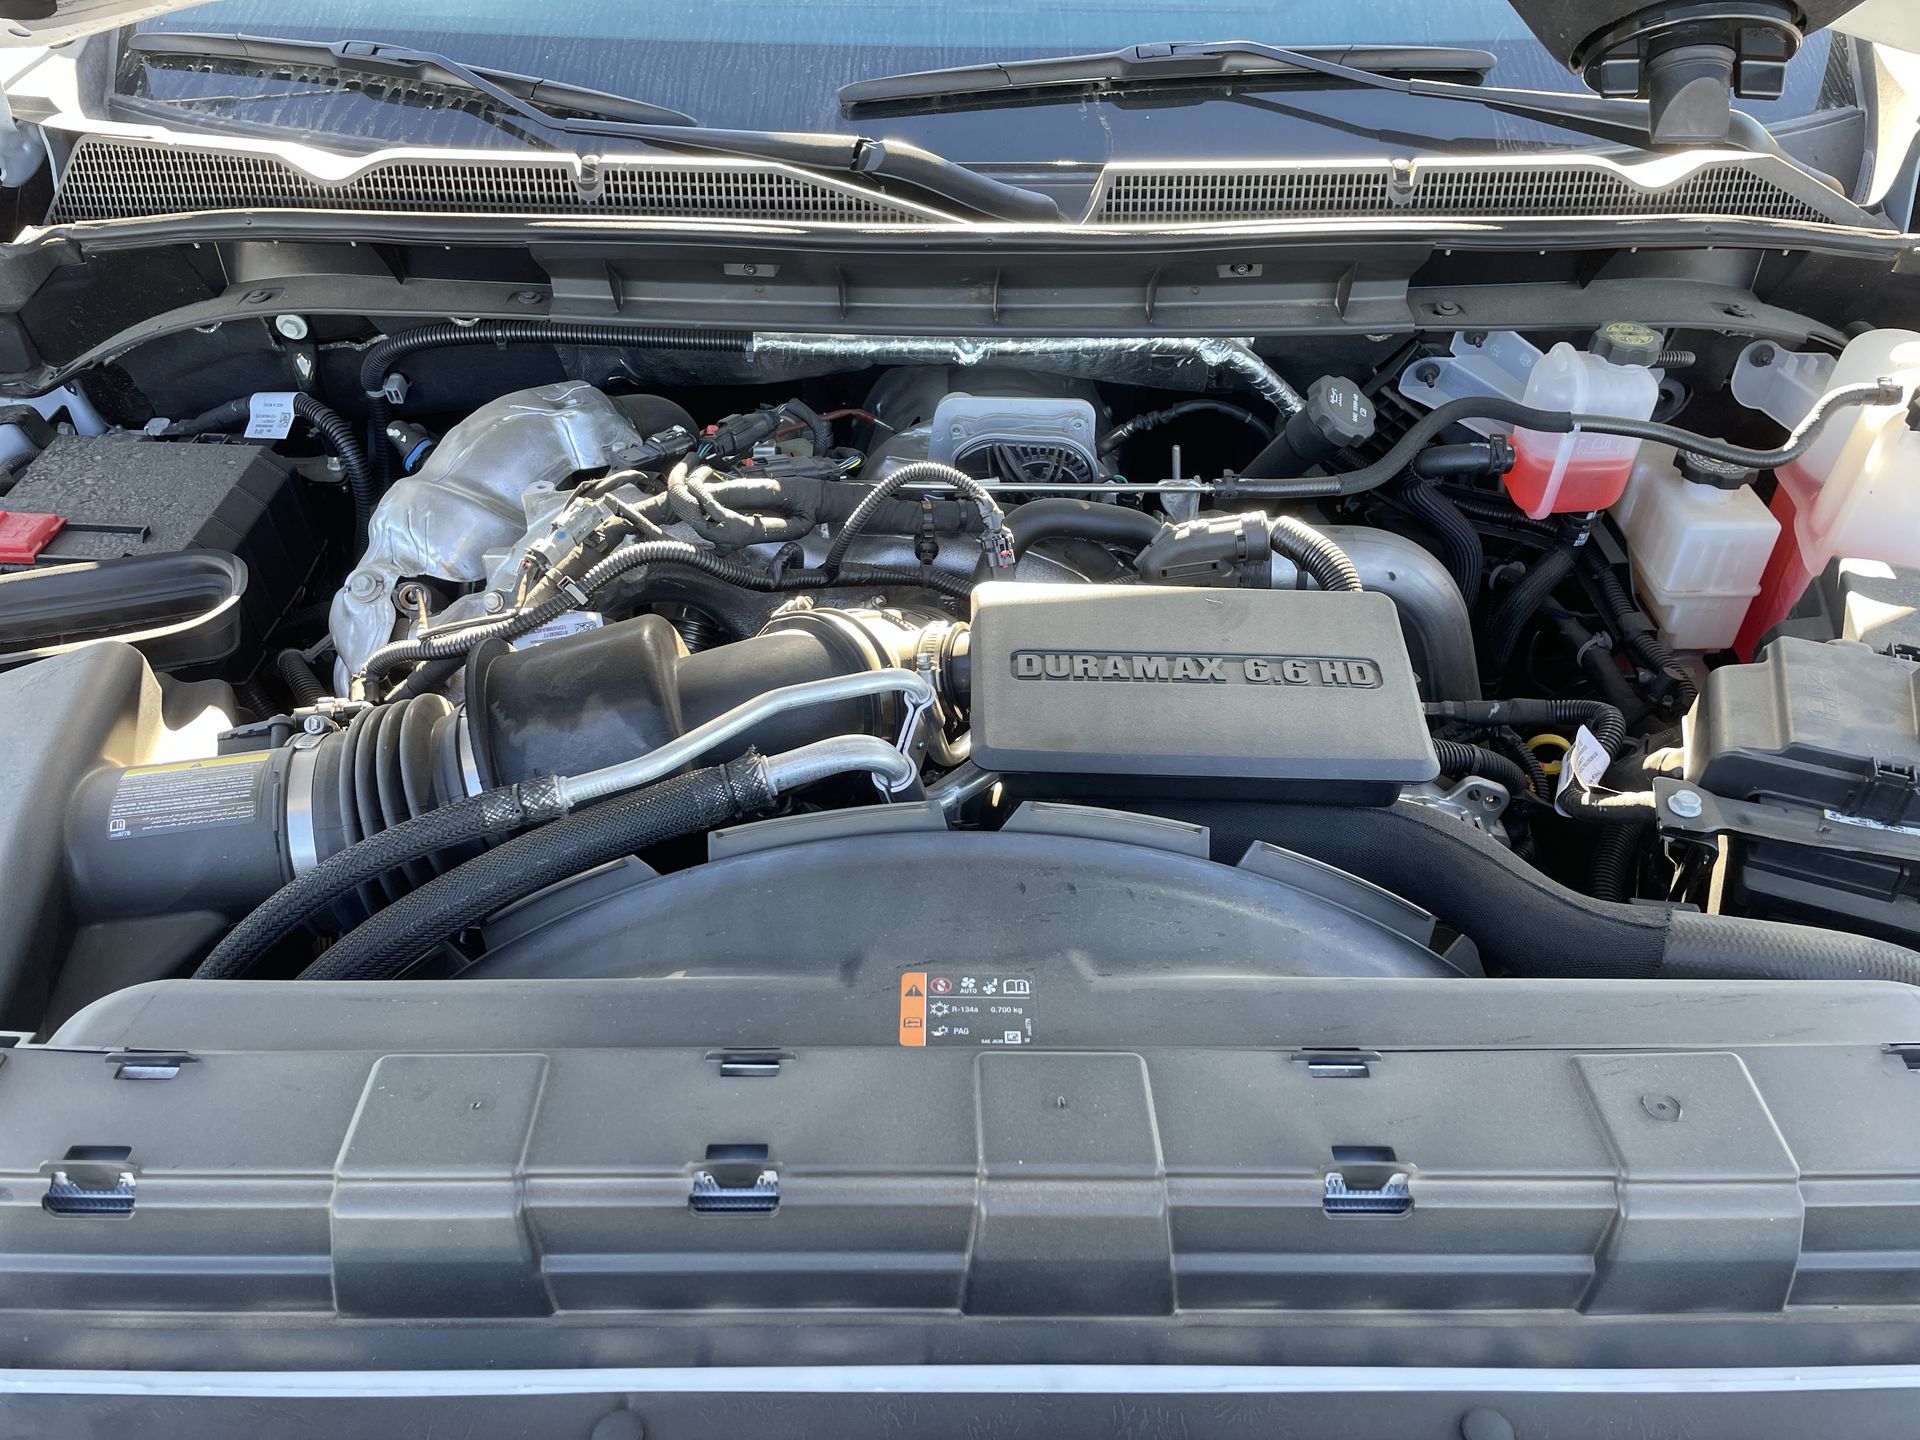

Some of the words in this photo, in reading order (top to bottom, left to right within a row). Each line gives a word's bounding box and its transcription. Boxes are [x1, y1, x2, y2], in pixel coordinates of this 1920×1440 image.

[1016, 653, 1226, 681] DURAMAX
[1244, 658, 1310, 684] 6.6
[1317, 660, 1376, 686] HD
[1013, 1006, 1023, 1014] kg
[953, 1027, 969, 1035] PAG
